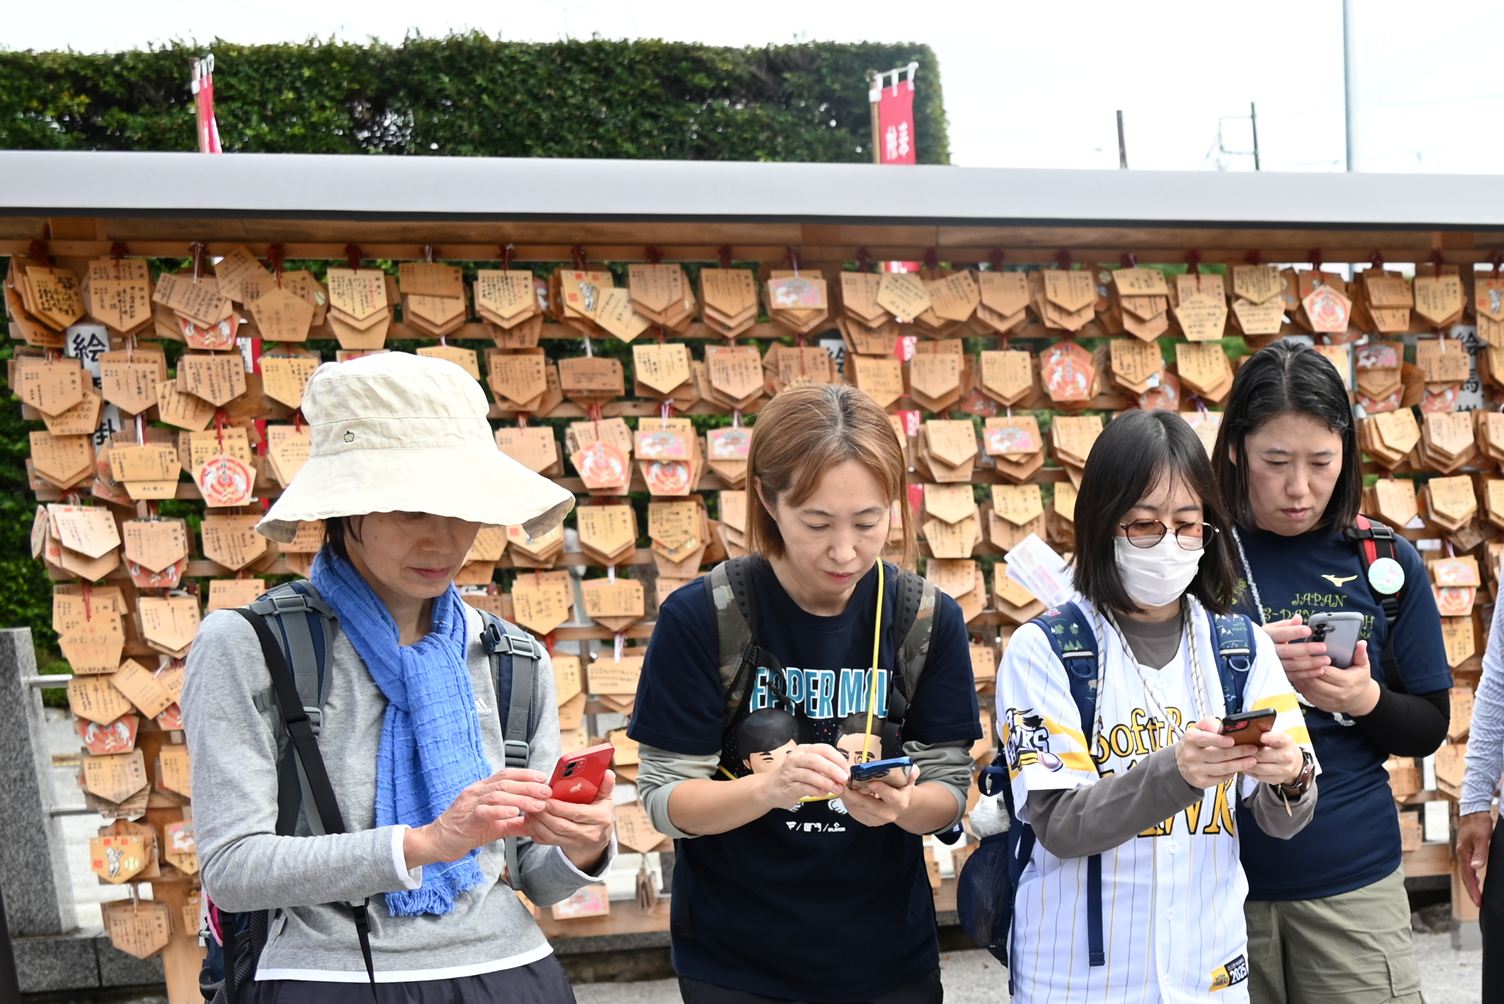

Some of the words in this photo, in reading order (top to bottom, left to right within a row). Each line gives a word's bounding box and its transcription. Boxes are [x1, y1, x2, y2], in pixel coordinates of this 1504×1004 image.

[1291, 592, 1347, 608] JAPAN
[750, 667, 835, 719] EPPER
[838, 668, 893, 718] MIL
[1230, 963, 1247, 983] 2025
